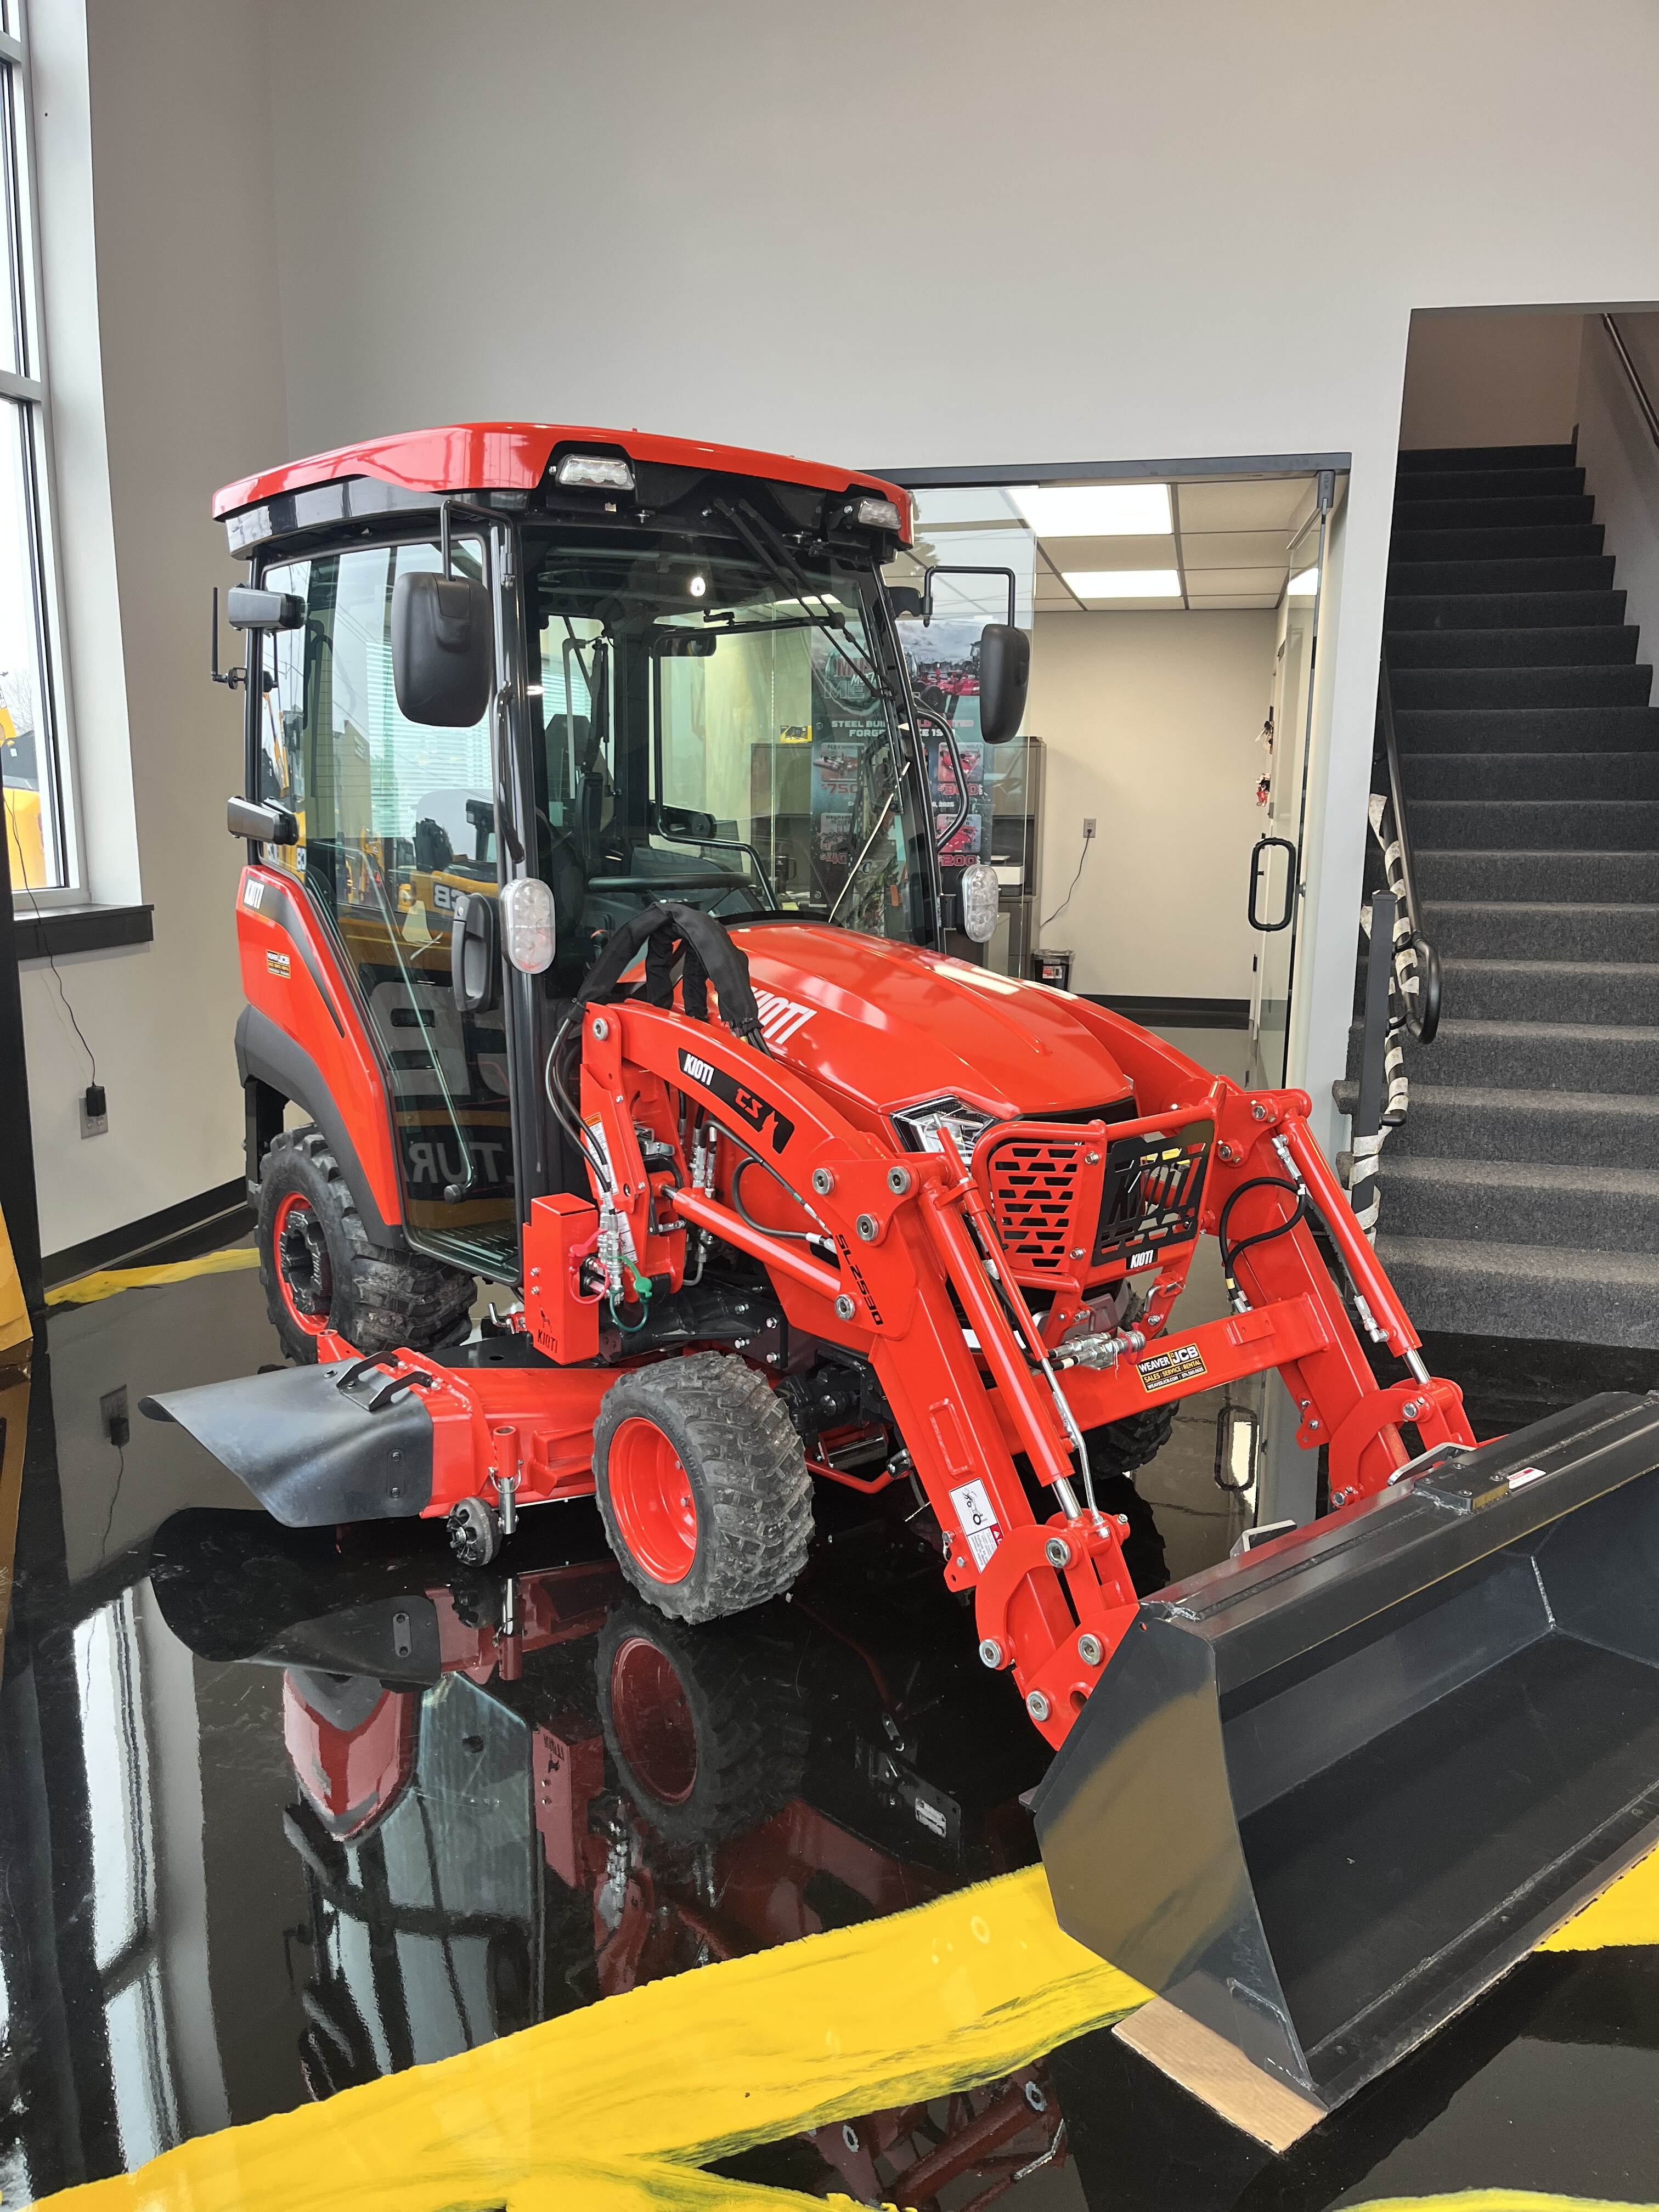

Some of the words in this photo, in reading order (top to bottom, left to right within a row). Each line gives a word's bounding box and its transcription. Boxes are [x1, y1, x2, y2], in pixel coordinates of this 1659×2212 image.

[938, 783, 979, 795] $30
[751, 985, 818, 1045] OTI
[683, 1053, 715, 1086] KIOTI
[1106, 1156, 1203, 1227] KIOTI
[1130, 1249, 1154, 1269] KIOTI
[835, 1234, 884, 1325] SL2530
[538, 1328, 558, 1355] KIOTI
[1138, 1356, 1171, 1373] WEAVER
[1172, 1346, 1199, 1364] JCB
[1144, 1373, 1161, 1383] SALES
[1162, 1365, 1182, 1377] SERVICE
[1183, 1359, 1202, 1370] RENTAL
